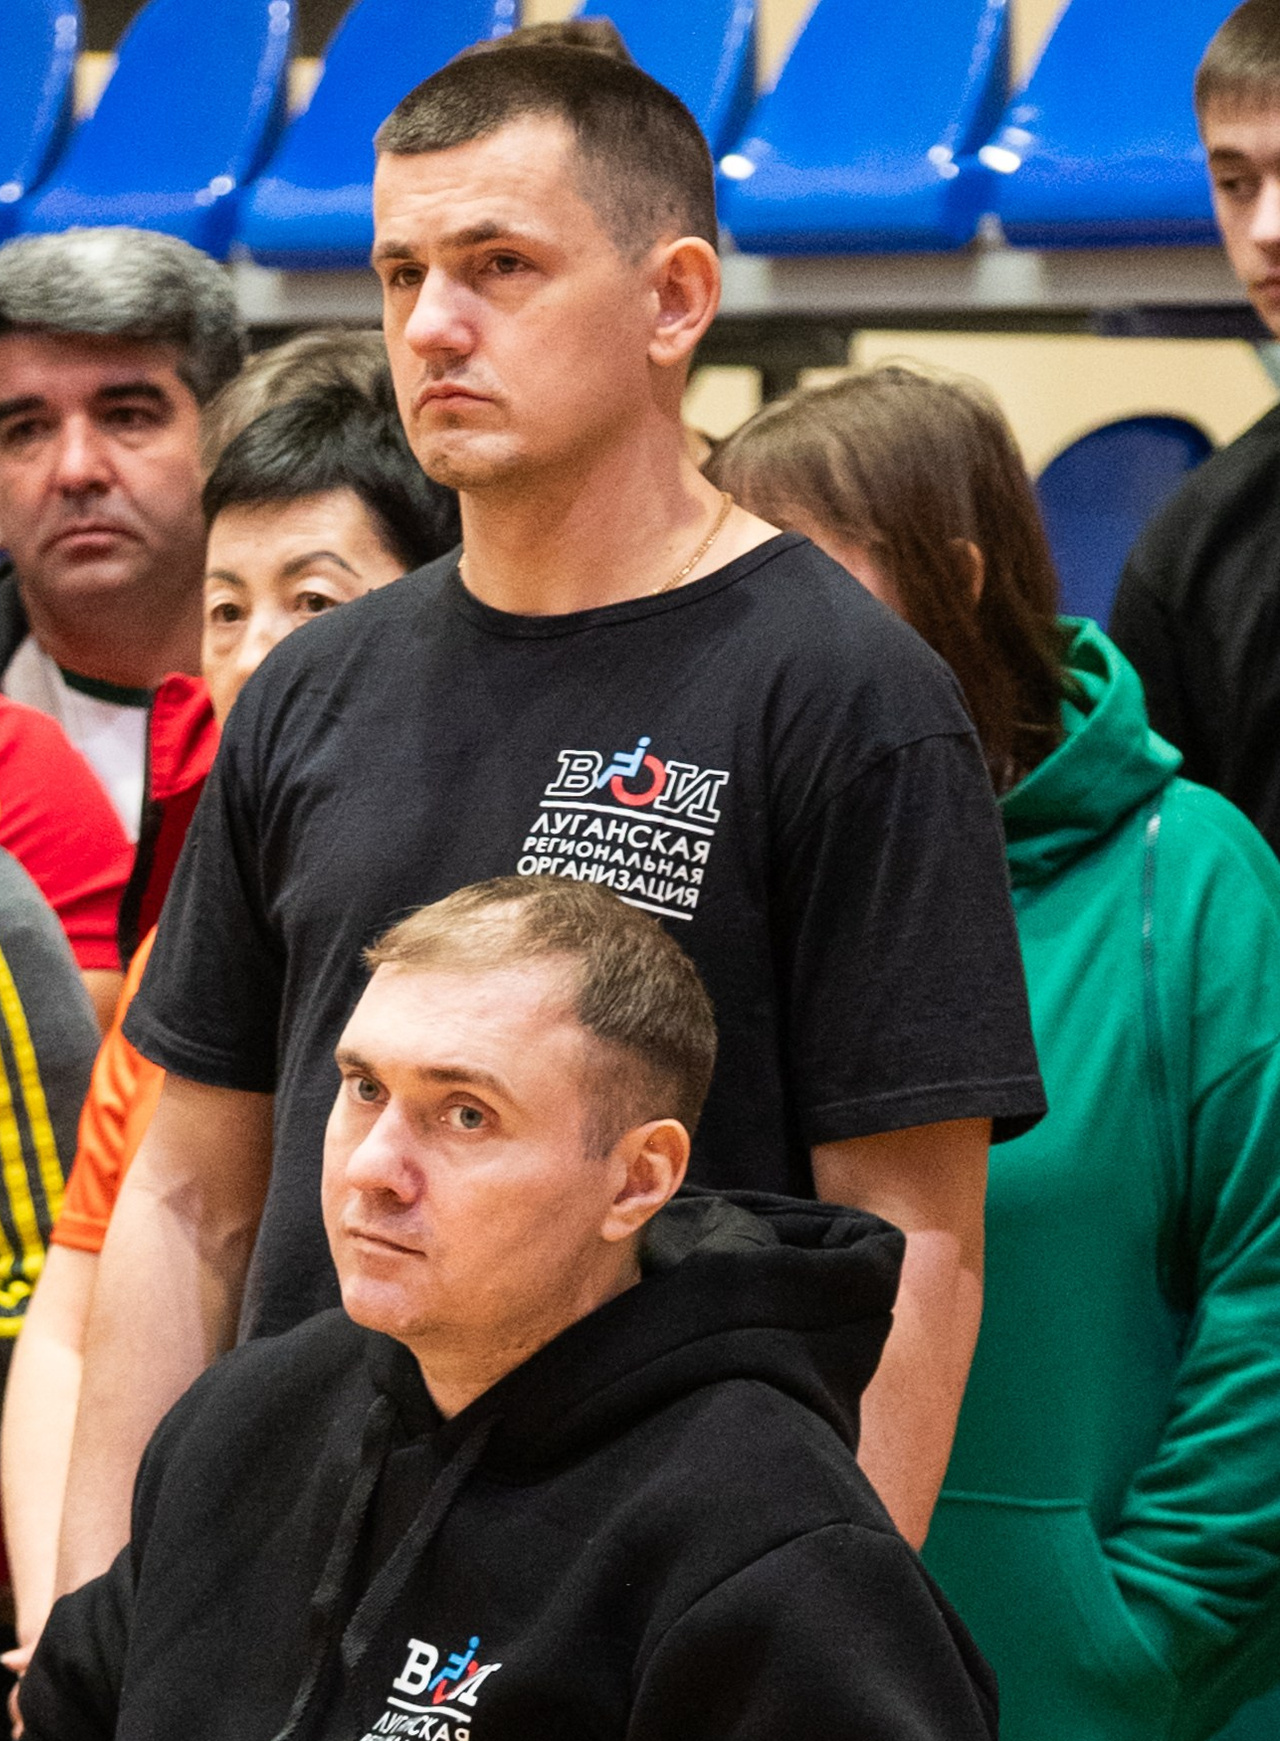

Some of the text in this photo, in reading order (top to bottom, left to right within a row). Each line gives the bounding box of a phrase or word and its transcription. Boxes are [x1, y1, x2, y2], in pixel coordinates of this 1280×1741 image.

[522, 836, 705, 885] РЕГИОНАЛЬНАЯ
[529, 812, 711, 865] ЛУГАНСКАЯ
[516, 855, 700, 909] ОРГАНИЗАЦИЯ
